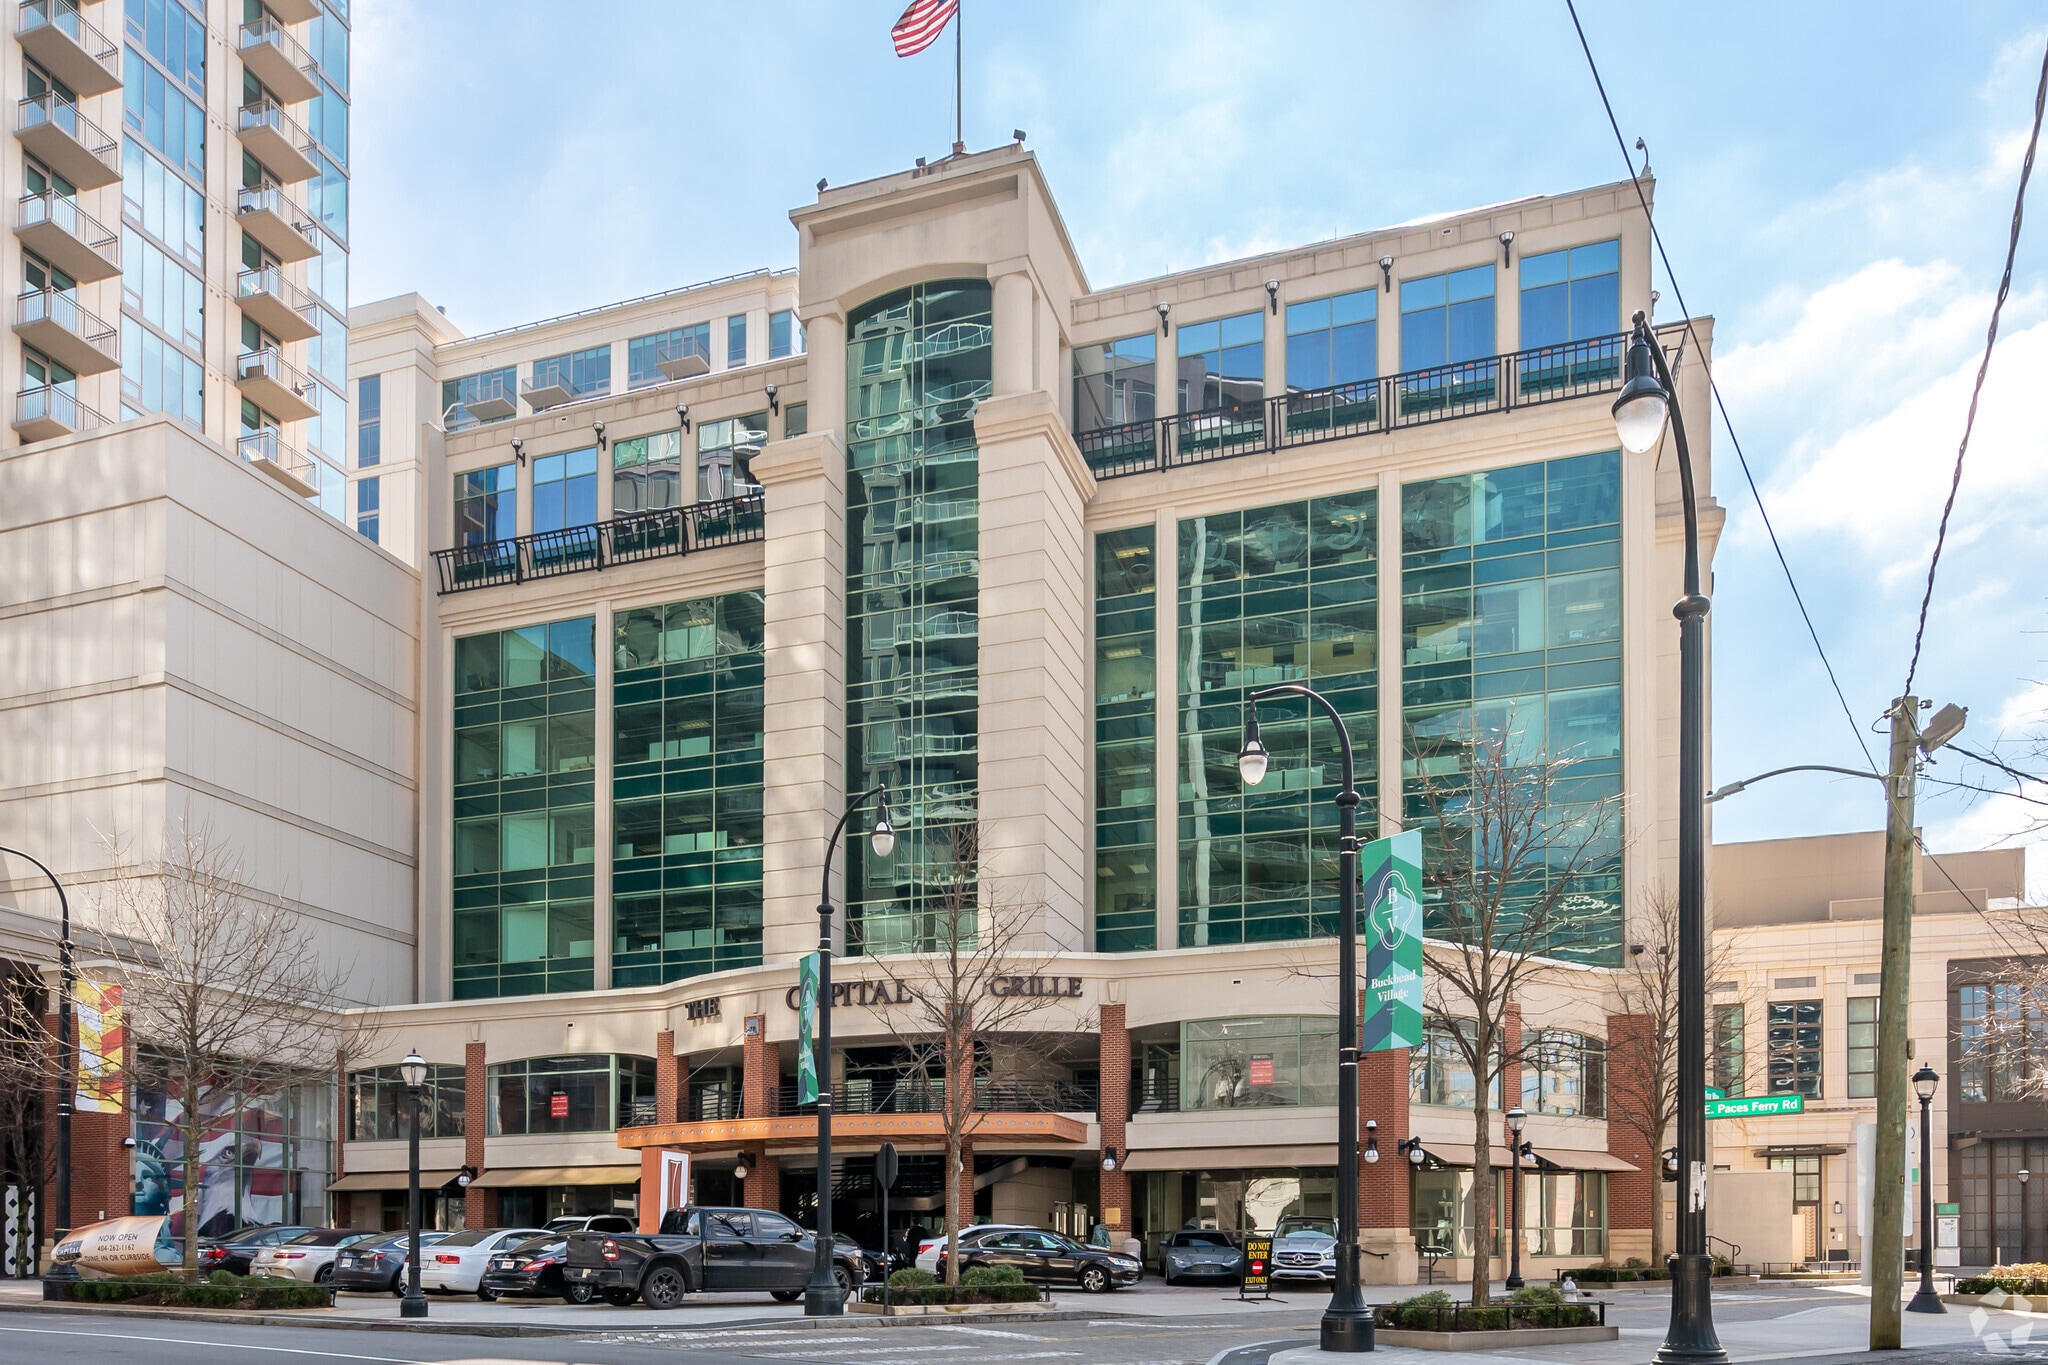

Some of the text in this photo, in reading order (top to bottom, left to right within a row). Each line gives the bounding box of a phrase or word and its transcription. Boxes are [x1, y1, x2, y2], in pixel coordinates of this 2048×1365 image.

[1387, 886, 1398, 905] B
[1387, 915, 1399, 934] V
[1371, 969, 1416, 990] Buckhead
[684, 975, 1083, 1021] THE CPITAL GRILLE
[1377, 988, 1409, 1003] Village
[1717, 1103, 1749, 1114] Paces
[1751, 1101, 1779, 1112] Ferry
[1782, 1099, 1798, 1109] Rd
[98, 1233, 138, 1242] NOW OPEN
[97, 1243, 135, 1252] 404-262-1162
[1247, 1242, 1271, 1250] DO NOT
[119, 1253, 151, 1261] CURBSIDE
[1248, 1251, 1268, 1259] ENTER
